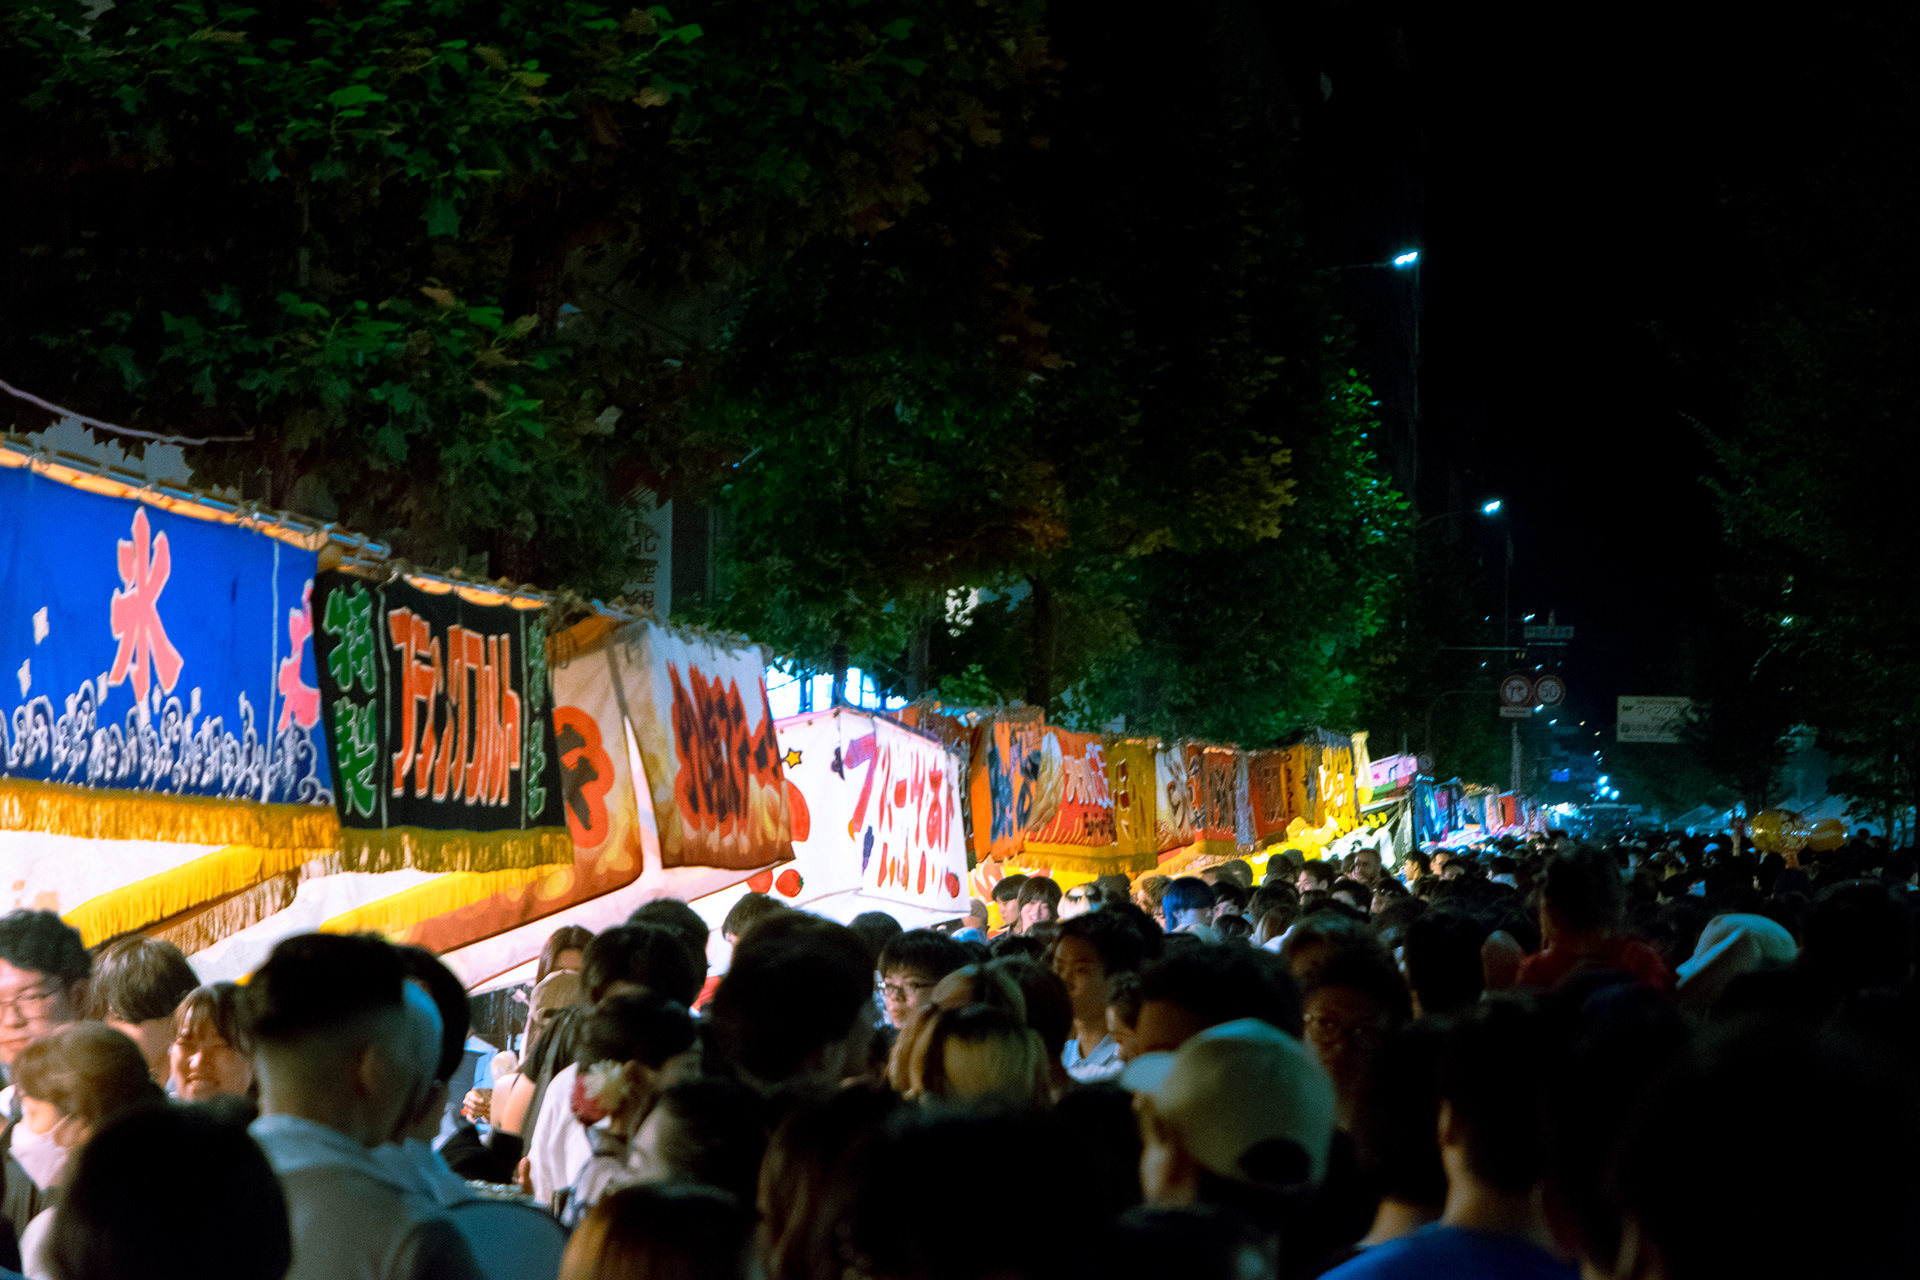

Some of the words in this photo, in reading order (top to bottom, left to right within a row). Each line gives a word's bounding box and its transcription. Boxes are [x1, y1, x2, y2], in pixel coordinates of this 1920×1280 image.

[109, 506, 184, 704] 氷
[322, 580, 378, 819] 特製
[1541, 684, 1558, 698] 50
[387, 606, 521, 808] フランクフルト
